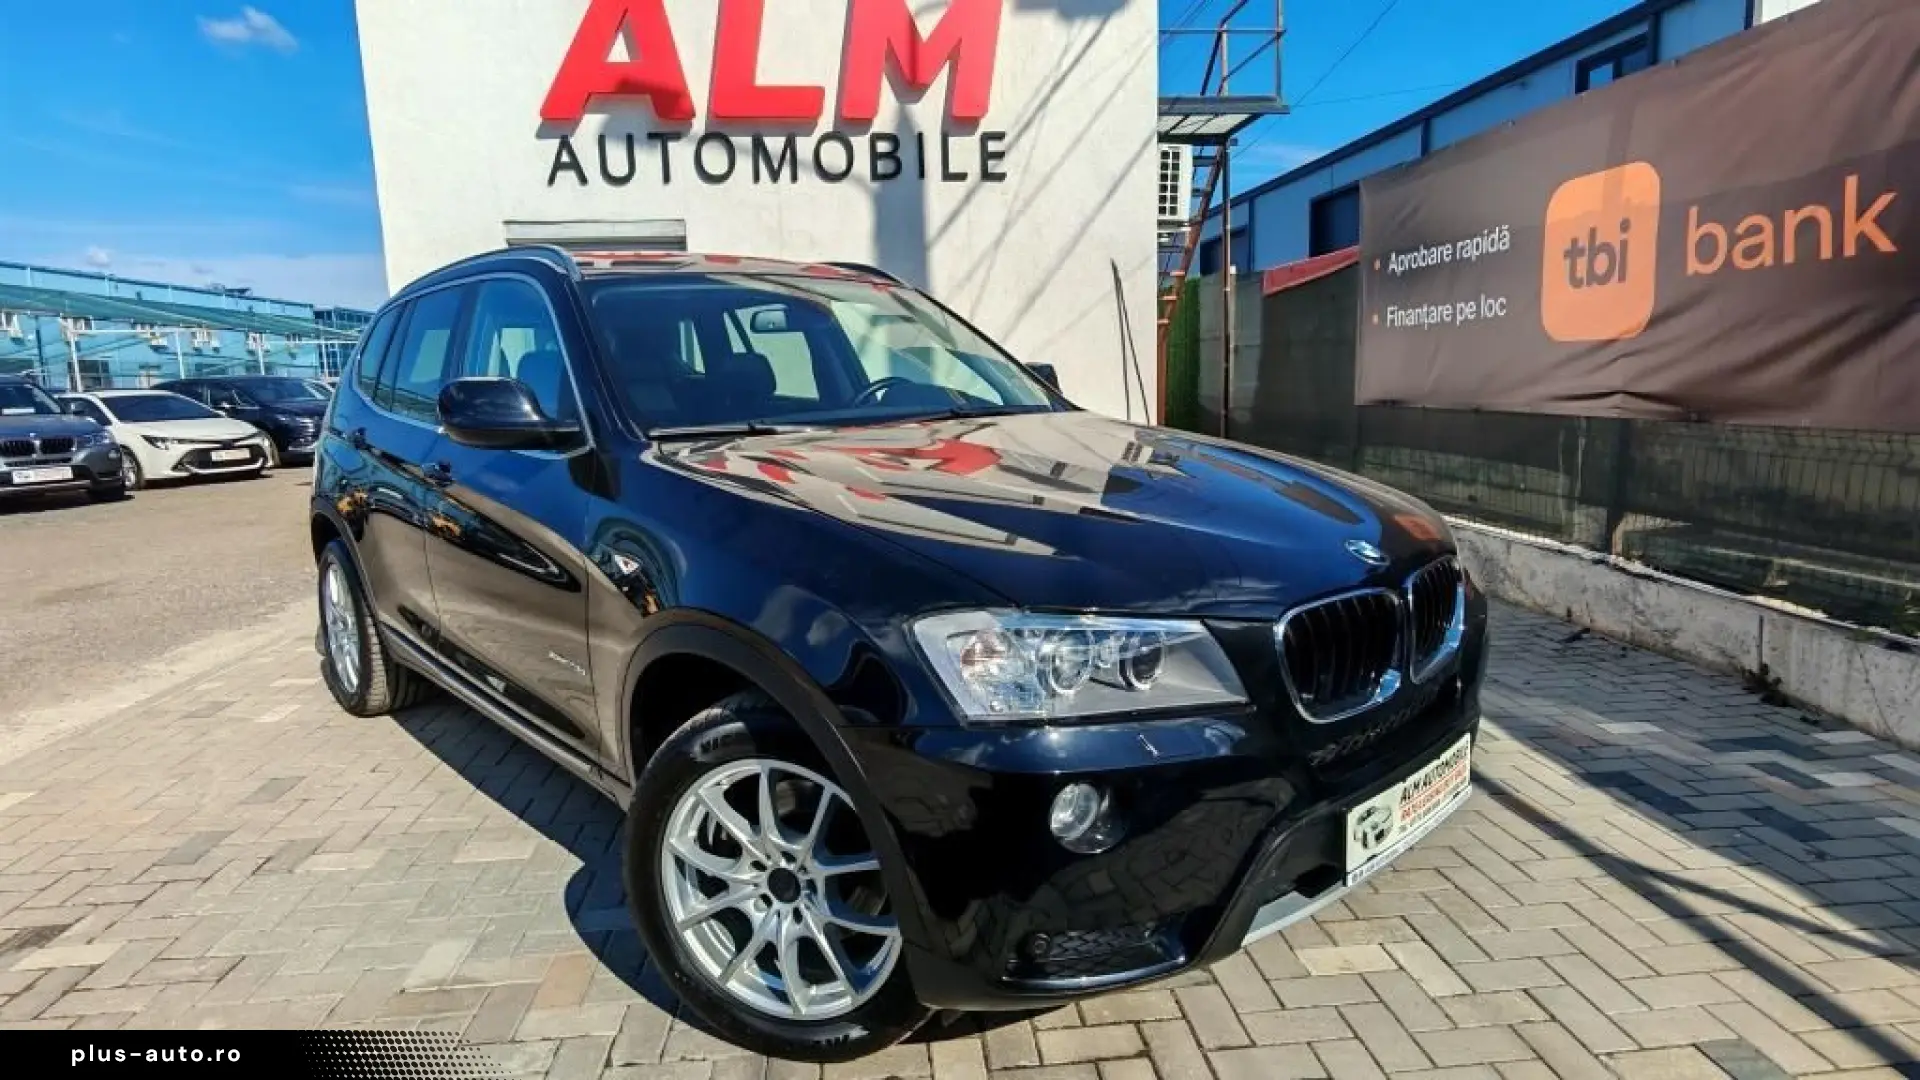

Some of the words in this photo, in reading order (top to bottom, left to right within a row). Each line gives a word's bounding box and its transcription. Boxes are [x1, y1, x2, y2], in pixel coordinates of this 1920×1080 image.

[540, 0, 1001, 120] ALM
[547, 130, 1008, 187] AUTOMOBILE
[1387, 243, 1453, 276] Aprobare
[1456, 224, 1511, 262] rapidă
[1563, 218, 1631, 289] tbi
[1684, 174, 1898, 276] bank
[1386, 303, 1453, 330] Finanțare
[1456, 300, 1477, 326] pe
[1480, 293, 1507, 318] loc
